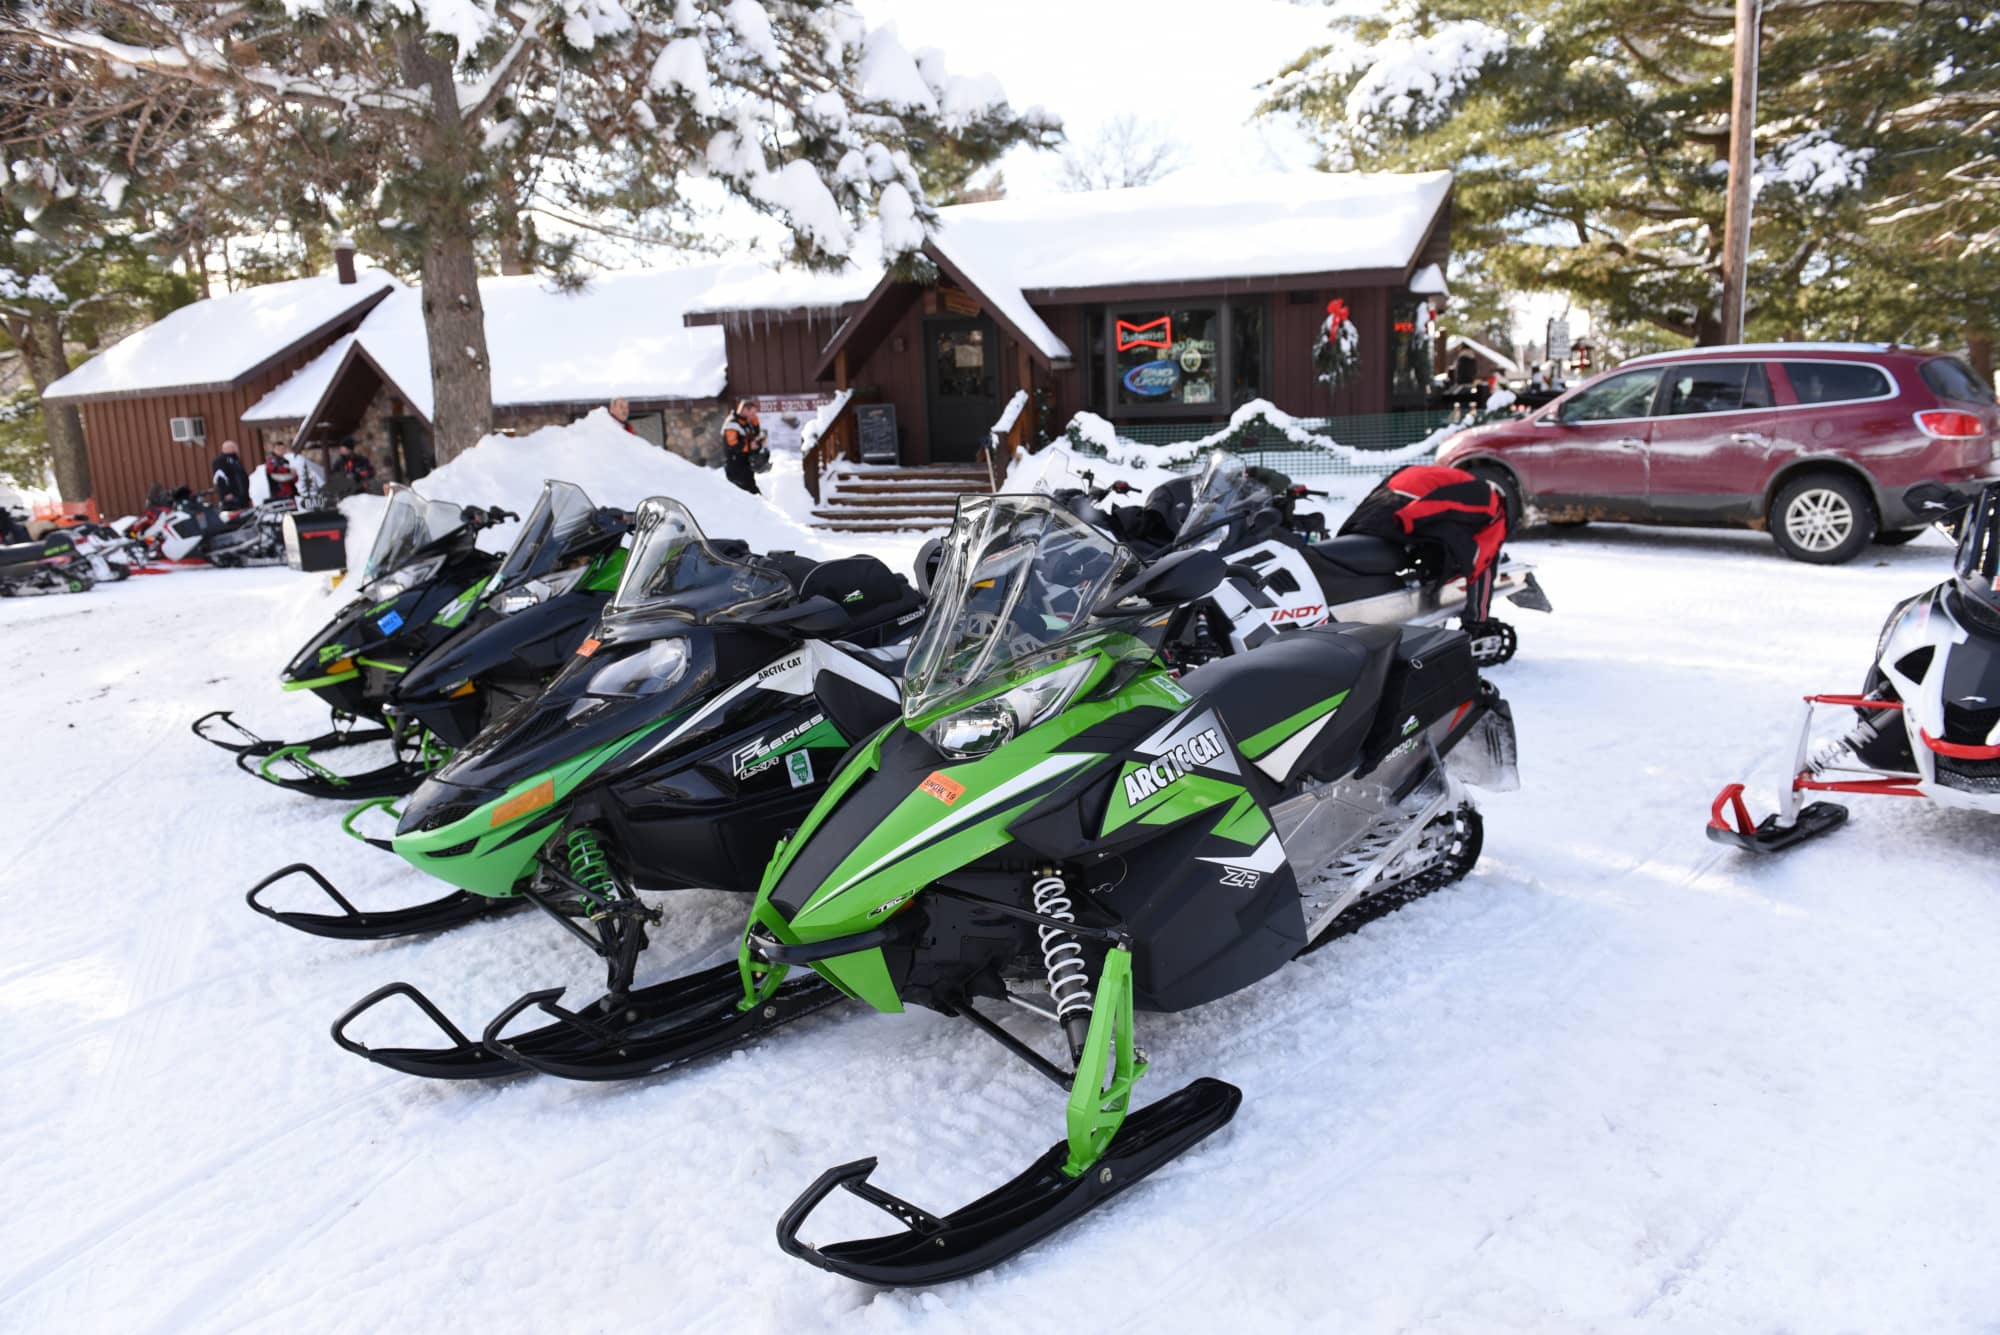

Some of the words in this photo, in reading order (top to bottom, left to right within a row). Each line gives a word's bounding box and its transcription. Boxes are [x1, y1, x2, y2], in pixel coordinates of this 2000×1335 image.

[1132, 376, 1177, 387] LIGHT
[1140, 367, 1174, 378] BUD
[759, 400, 777, 413] HOT
[780, 399, 809, 412] DRINK
[1270, 604, 1323, 622] INDY
[757, 662, 786, 681] ARCTIC
[786, 656, 802, 669] CAT
[756, 712, 825, 758] SERIES
[1123, 744, 1195, 809] ARCTIC
[1187, 727, 1225, 765] CAT
[1219, 865, 1260, 889] ZR
